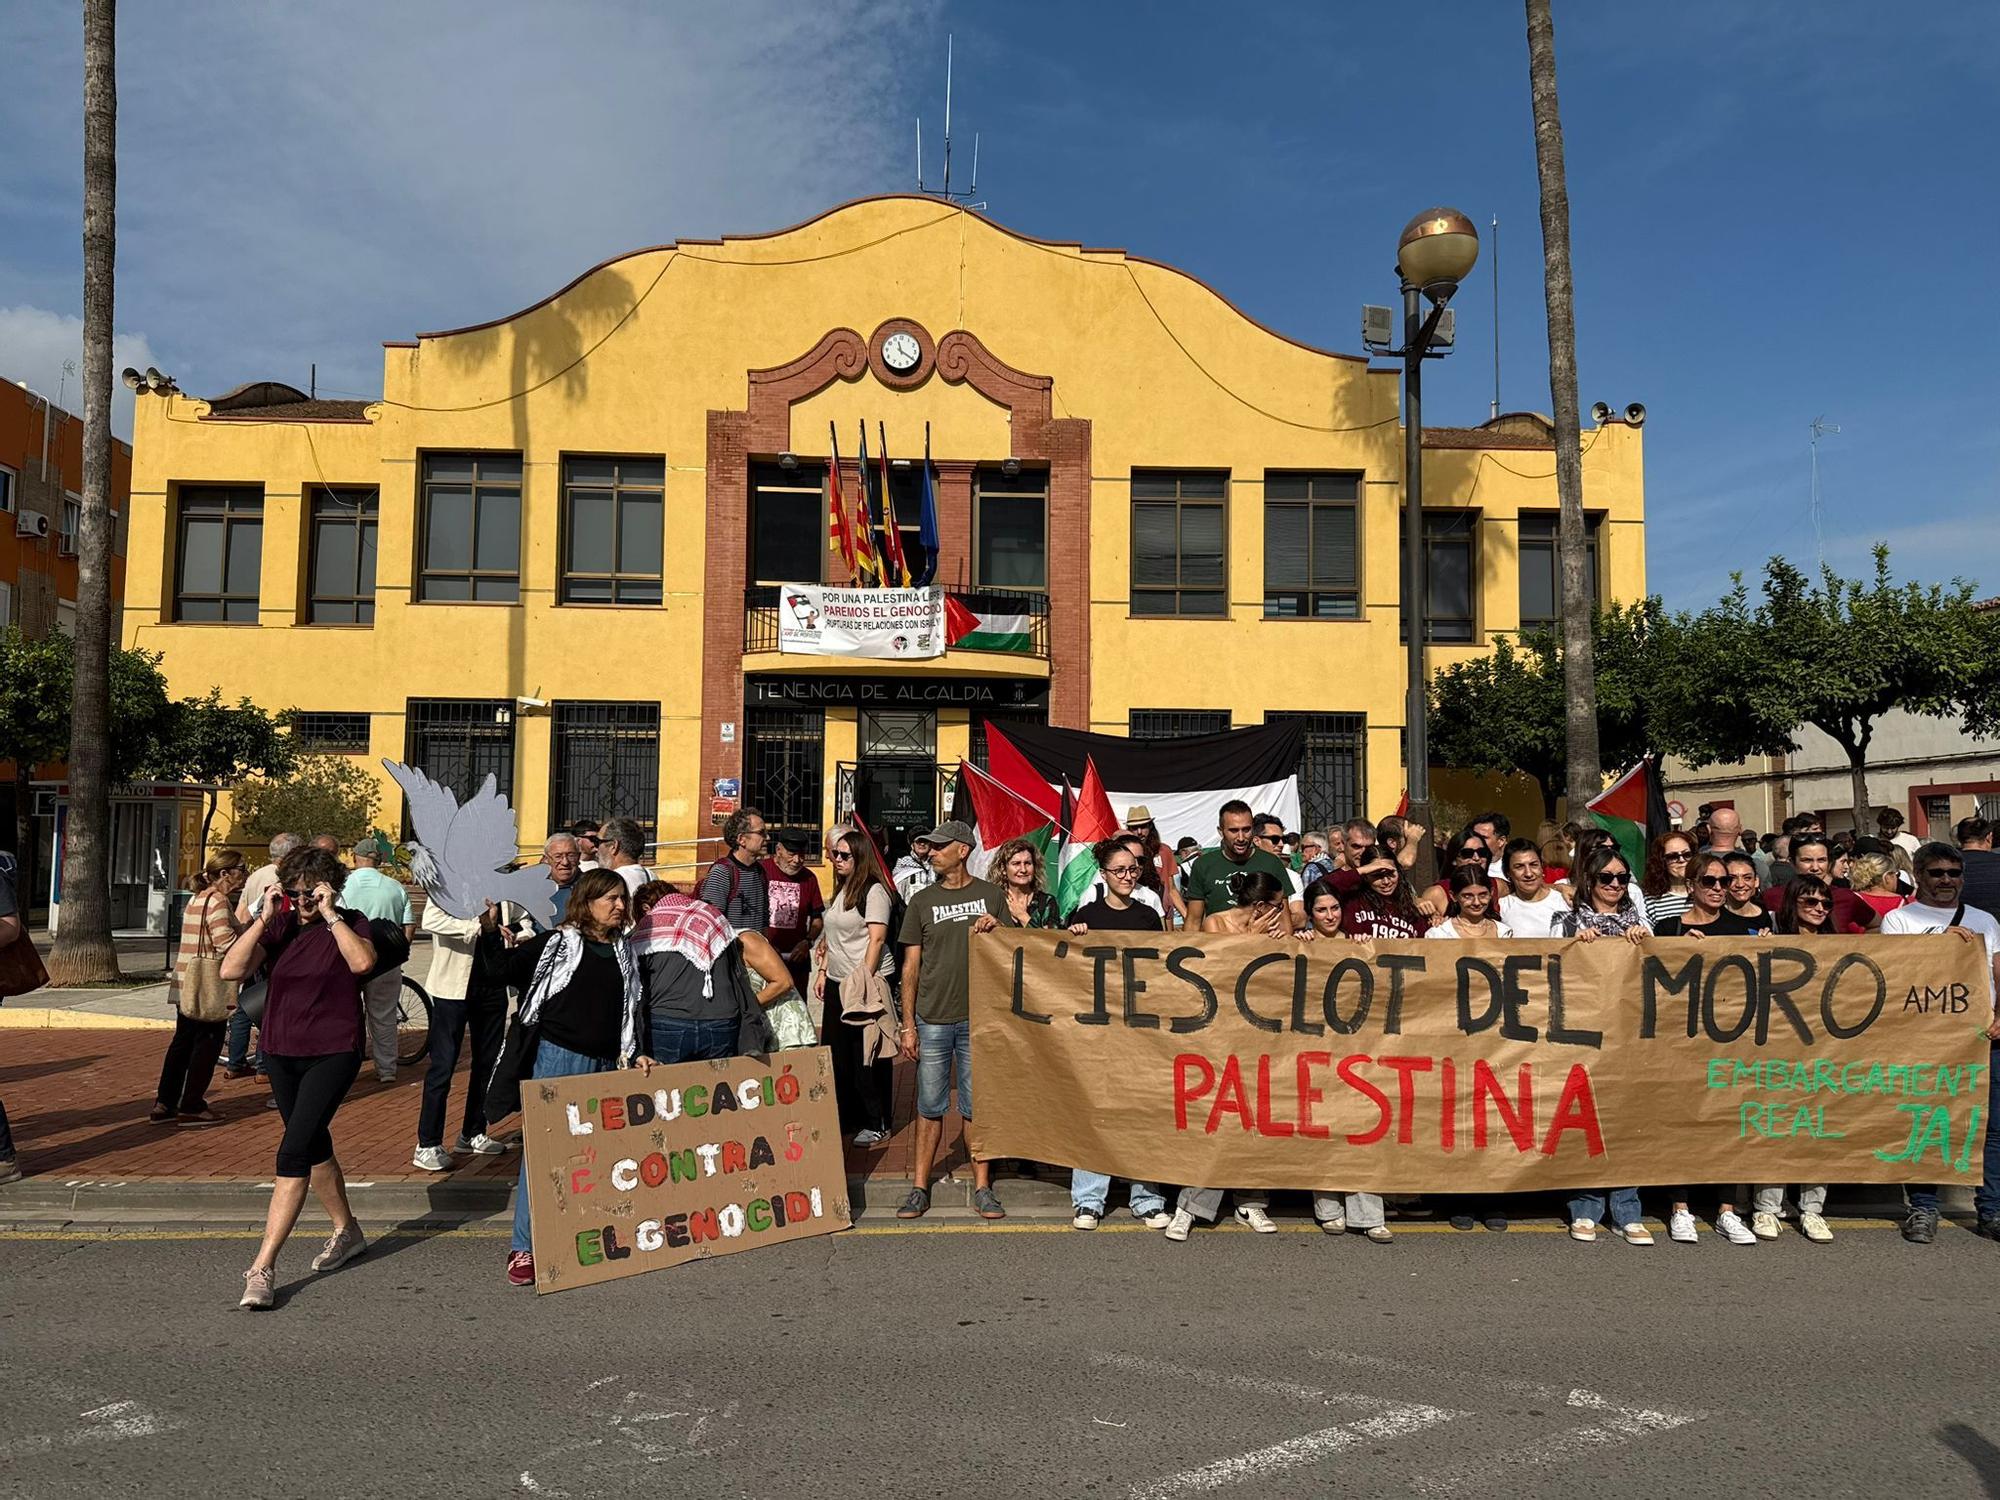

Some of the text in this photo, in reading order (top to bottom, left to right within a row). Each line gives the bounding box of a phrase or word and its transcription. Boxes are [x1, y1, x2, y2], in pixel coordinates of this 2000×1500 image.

[822, 590, 941, 604] POR UNA PALESTINA LBRE
[824, 605, 870, 618] PAREMOS
[873, 607, 888, 618] EL
[863, 620, 904, 630] RELACIONES
[905, 620, 919, 629] CON
[755, 681, 994, 701] TENENCIA DE ALCALDIA
[932, 898, 987, 922] PALESTINA
[1010, 940, 1971, 1050] L'IES CLOT DEL MORO AMB
[565, 1064, 800, 1137] L'EDUCACIÓ
[1706, 1057, 1987, 1097] EMBARGAMENT
[1171, 1050, 1607, 1160] PALESTINA
[1739, 1101, 1982, 1174] REAL JA!
[610, 1135, 776, 1193] CONTRA
[574, 1185, 824, 1267] EL GENOCIDI
